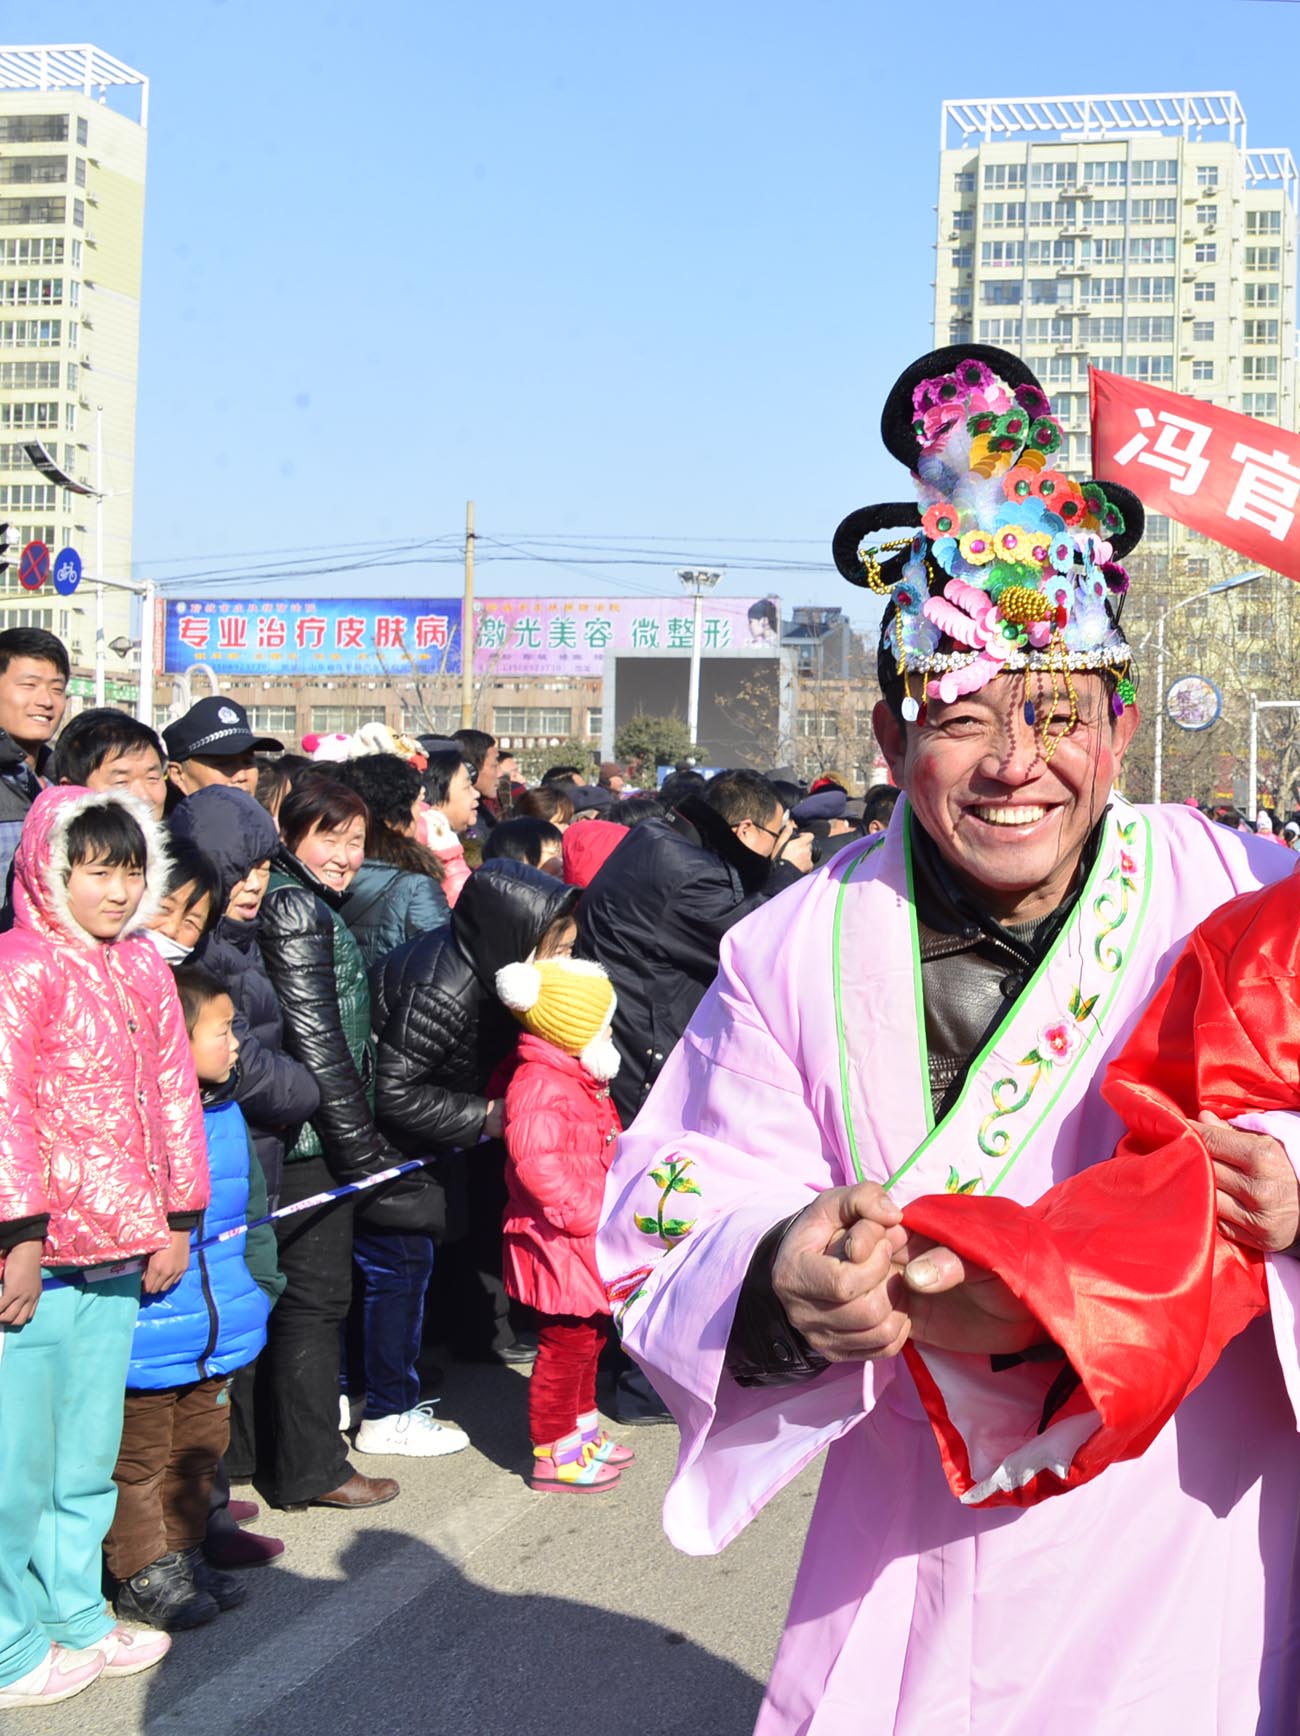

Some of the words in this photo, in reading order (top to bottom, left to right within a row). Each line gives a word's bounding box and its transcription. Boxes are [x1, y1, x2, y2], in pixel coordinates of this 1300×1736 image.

[179, 615, 448, 649] 专业治疗皮肤病
[477, 615, 613, 649] 激光美容
[632, 616, 732, 649] 微整形
